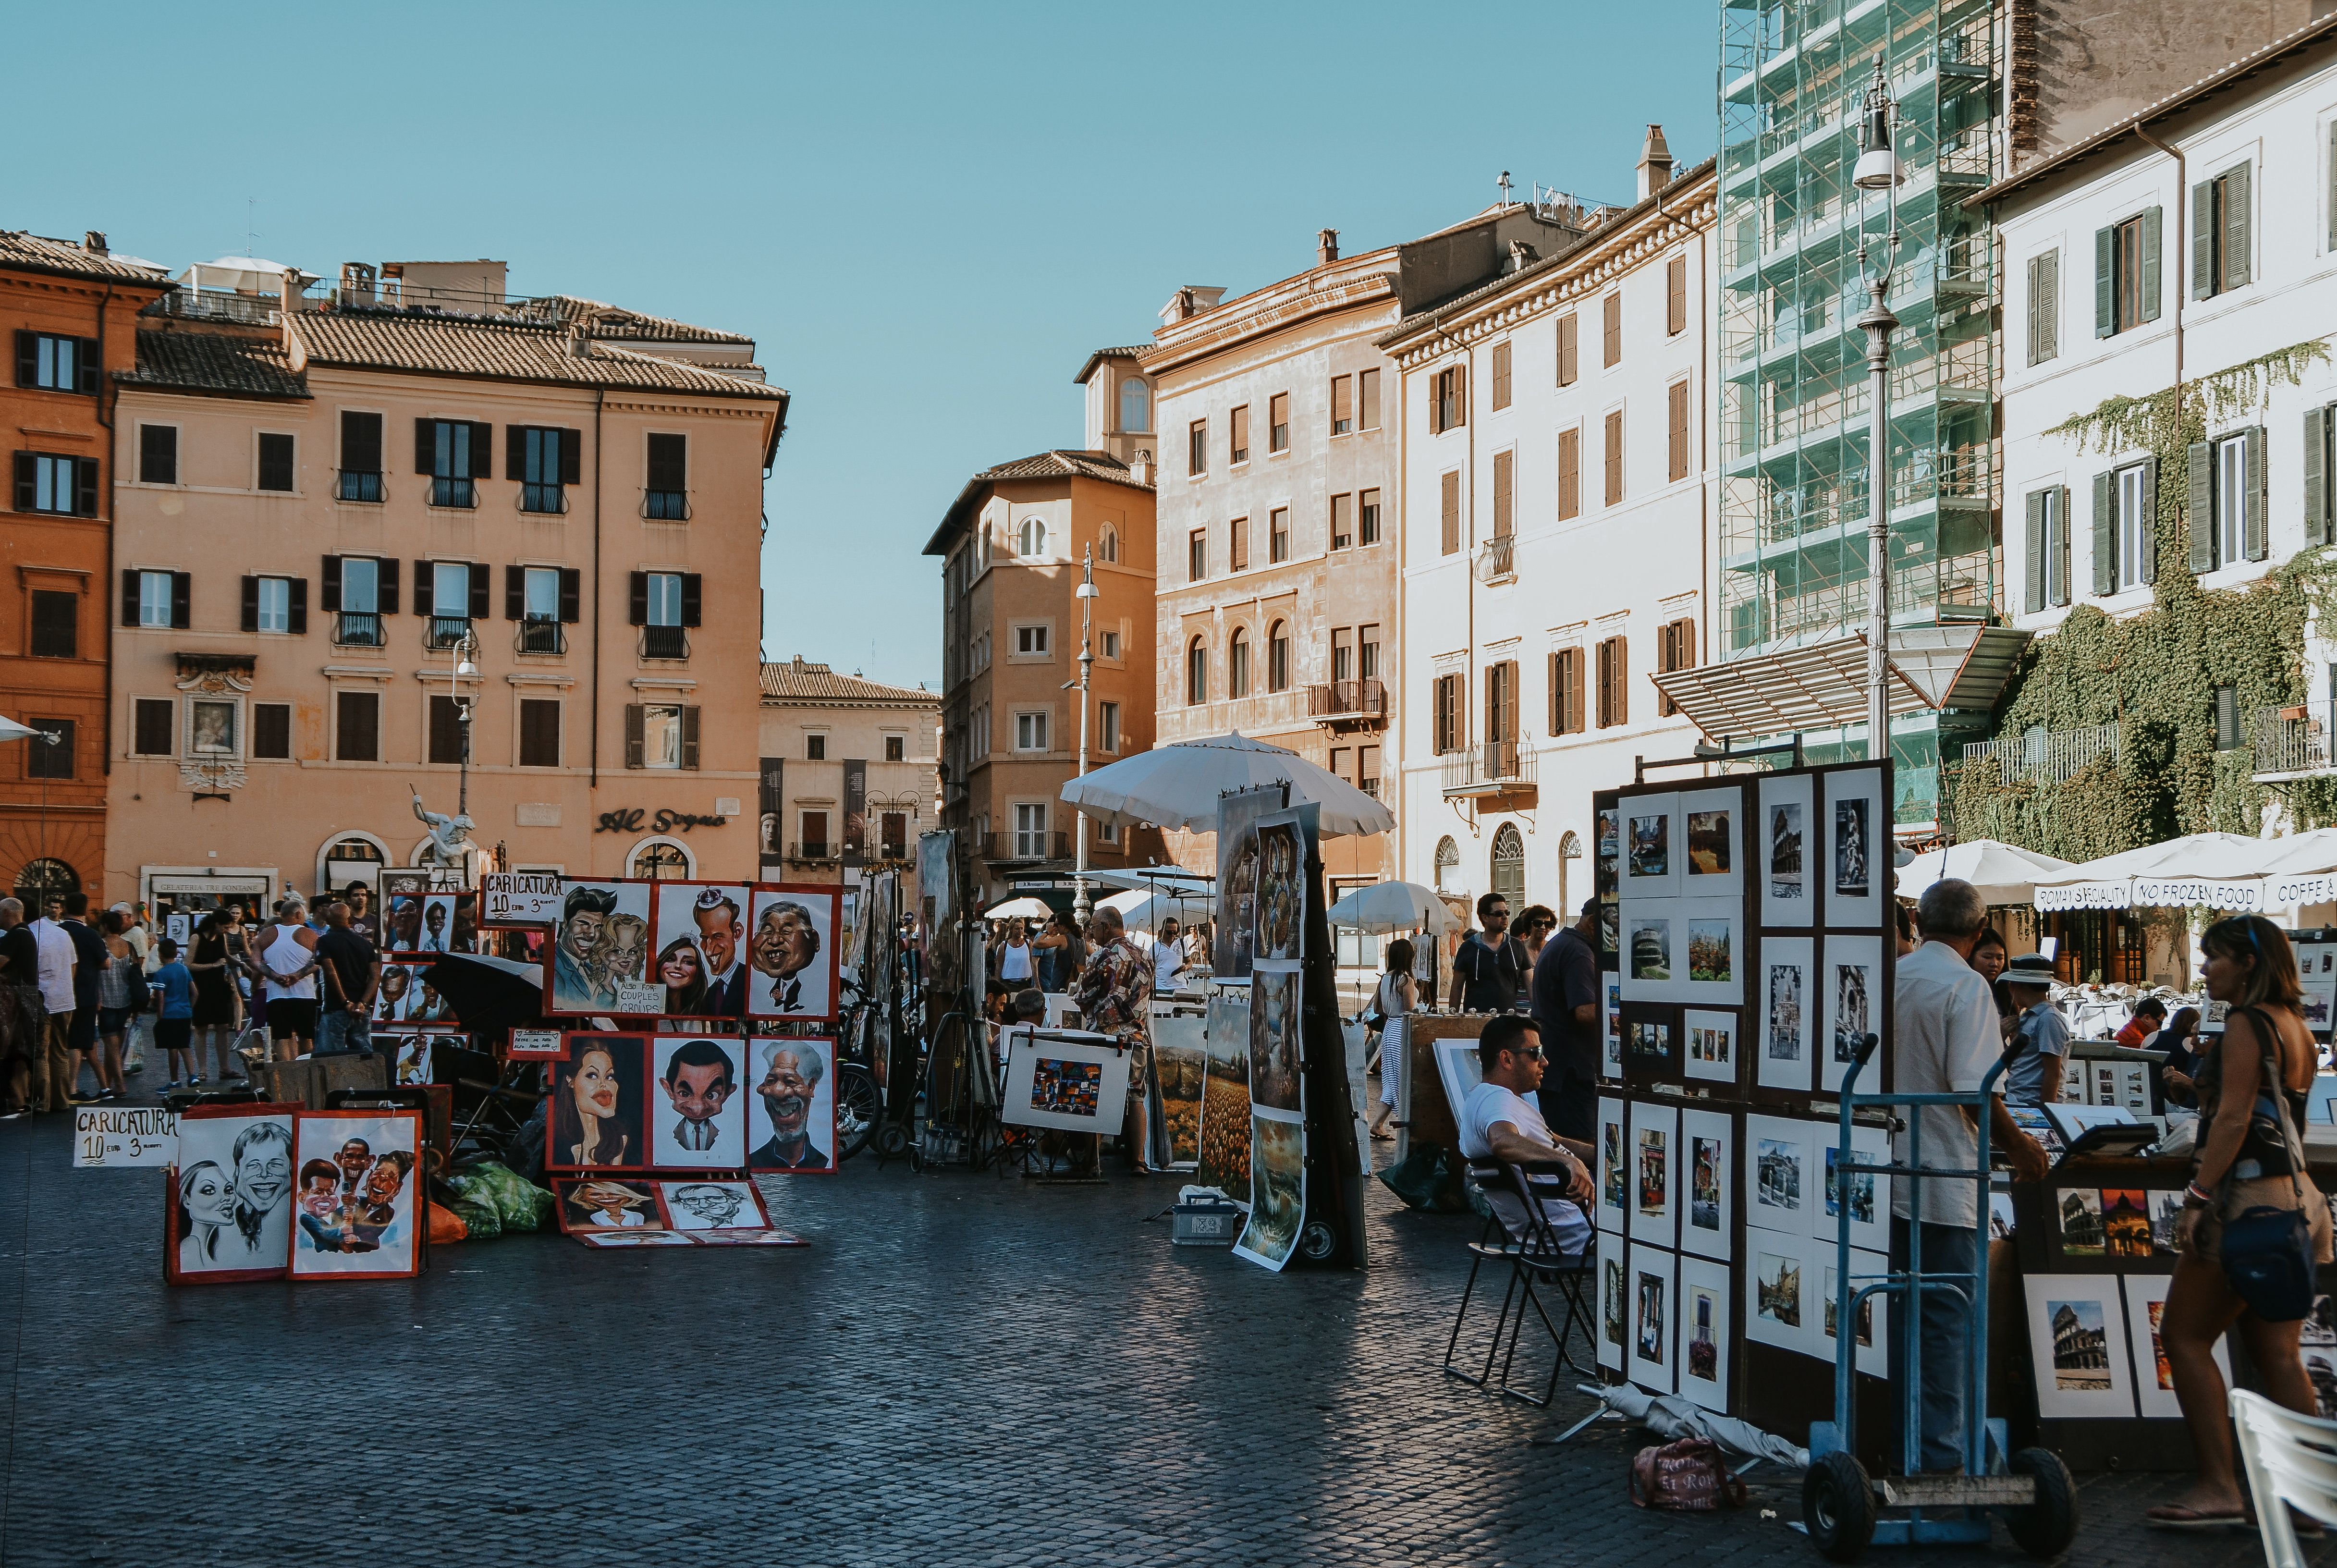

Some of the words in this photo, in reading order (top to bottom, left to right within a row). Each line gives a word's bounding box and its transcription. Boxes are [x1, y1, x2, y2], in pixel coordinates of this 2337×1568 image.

[595, 808, 645, 833] Al
[652, 808, 726, 833] Sogno
[487, 875, 564, 896] CARICATURA
[2075, 887, 2126, 903] SPECIALITY
[2139, 884, 2158, 899] NO
[2163, 884, 2212, 901] FROZEN
[2216, 887, 2254, 904] FOOD
[2278, 881, 2323, 901] COFFE
[490, 894, 509, 912] 10
[531, 899, 541, 913] 3
[621, 991, 659, 1001] COUPLES
[620, 1003, 659, 1014] GROUPS
[77, 1109, 179, 1138] CARICATURA
[82, 1136, 104, 1159] 10
[130, 1138, 141, 1157] 3
